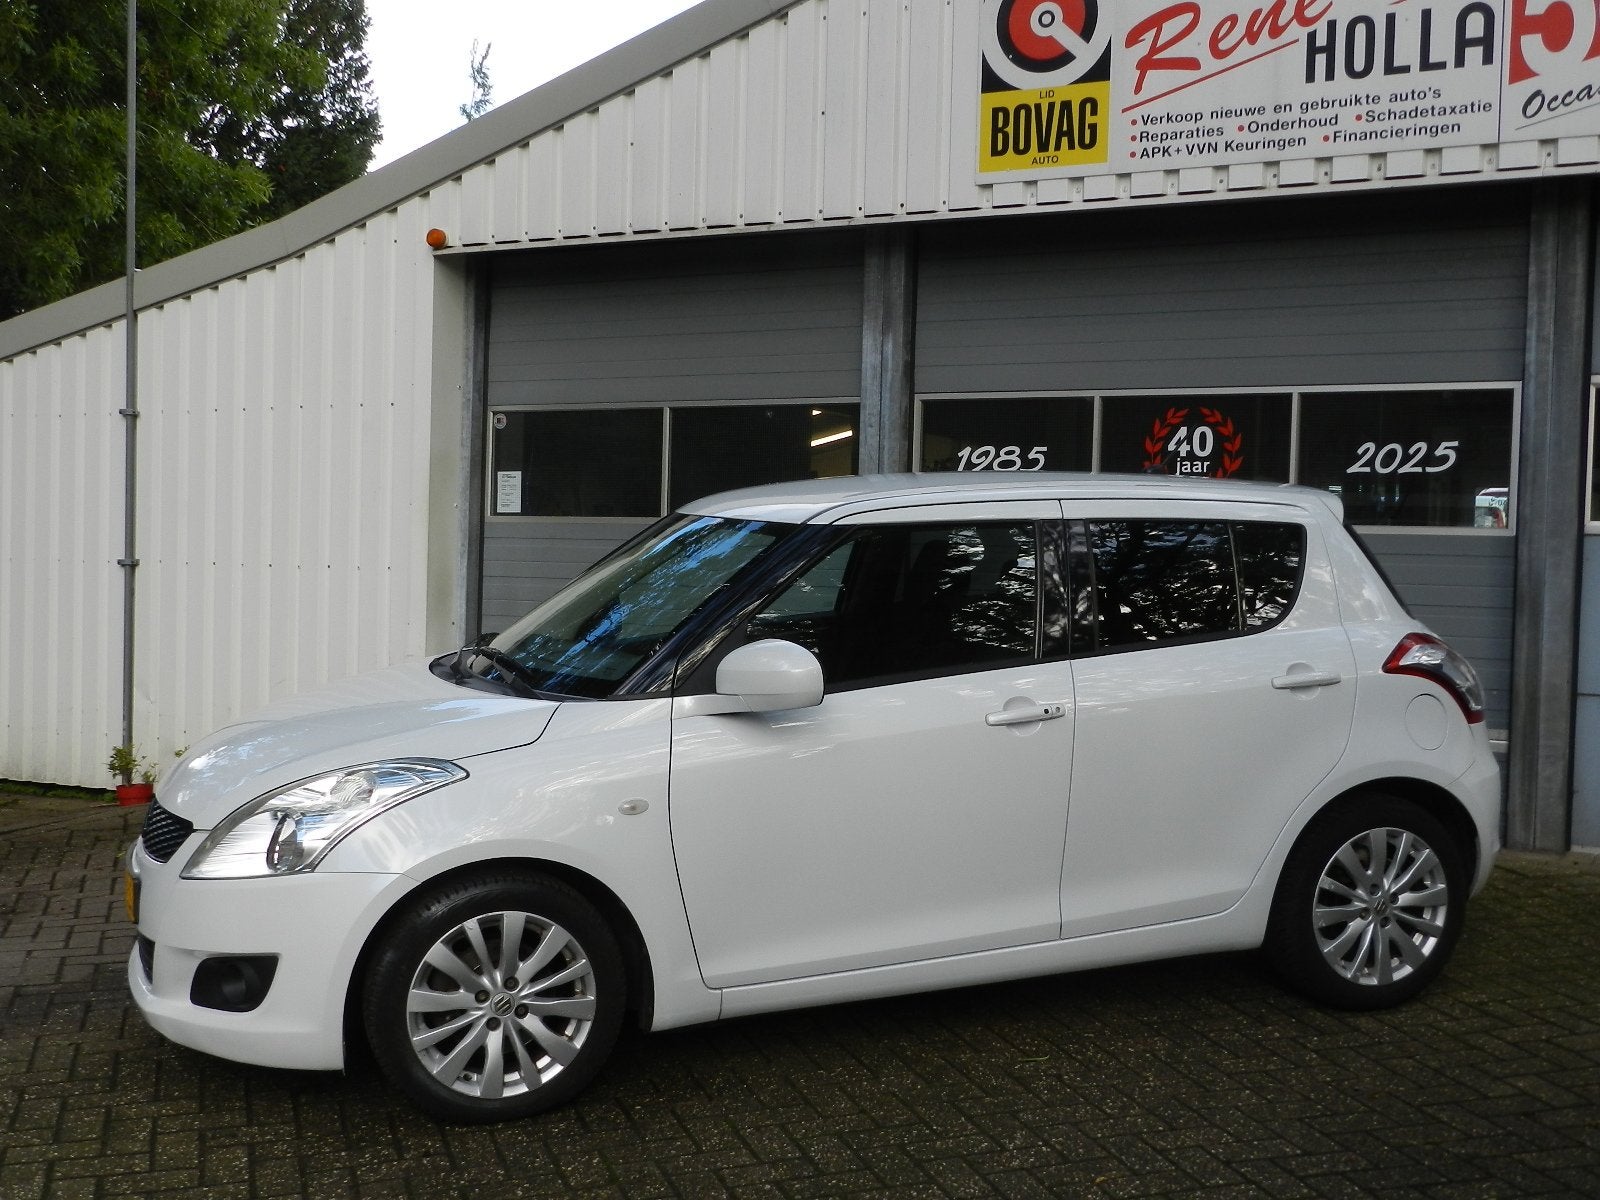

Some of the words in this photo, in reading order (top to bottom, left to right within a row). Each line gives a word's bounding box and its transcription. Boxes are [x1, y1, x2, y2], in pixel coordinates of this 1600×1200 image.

[1305, 2, 1496, 84] HOLLA
[1039, 90, 1055, 99] LID
[1141, 111, 1203, 126] Verkoop
[1210, 105, 1266, 120] nieuwe
[1273, 103, 1293, 114] en
[1300, 94, 1381, 114] gebruikte
[1389, 87, 1442, 102] auto's
[1521, 84, 1600, 119] Occa
[991, 97, 1099, 157] BOVAG
[1139, 126, 1224, 144] Reparaties
[1247, 113, 1339, 134] Onderhoud
[1365, 100, 1493, 123] Schadetaxatie
[1224, 136, 1307, 152] Keuringen
[1333, 122, 1461, 143] Financieringen
[1031, 155, 1059, 165] AUTO
[1167, 426, 1214, 457] 40
[1346, 441, 1459, 474] 2025
[957, 445, 1048, 472] 1985
[1175, 457, 1210, 476] jaar
